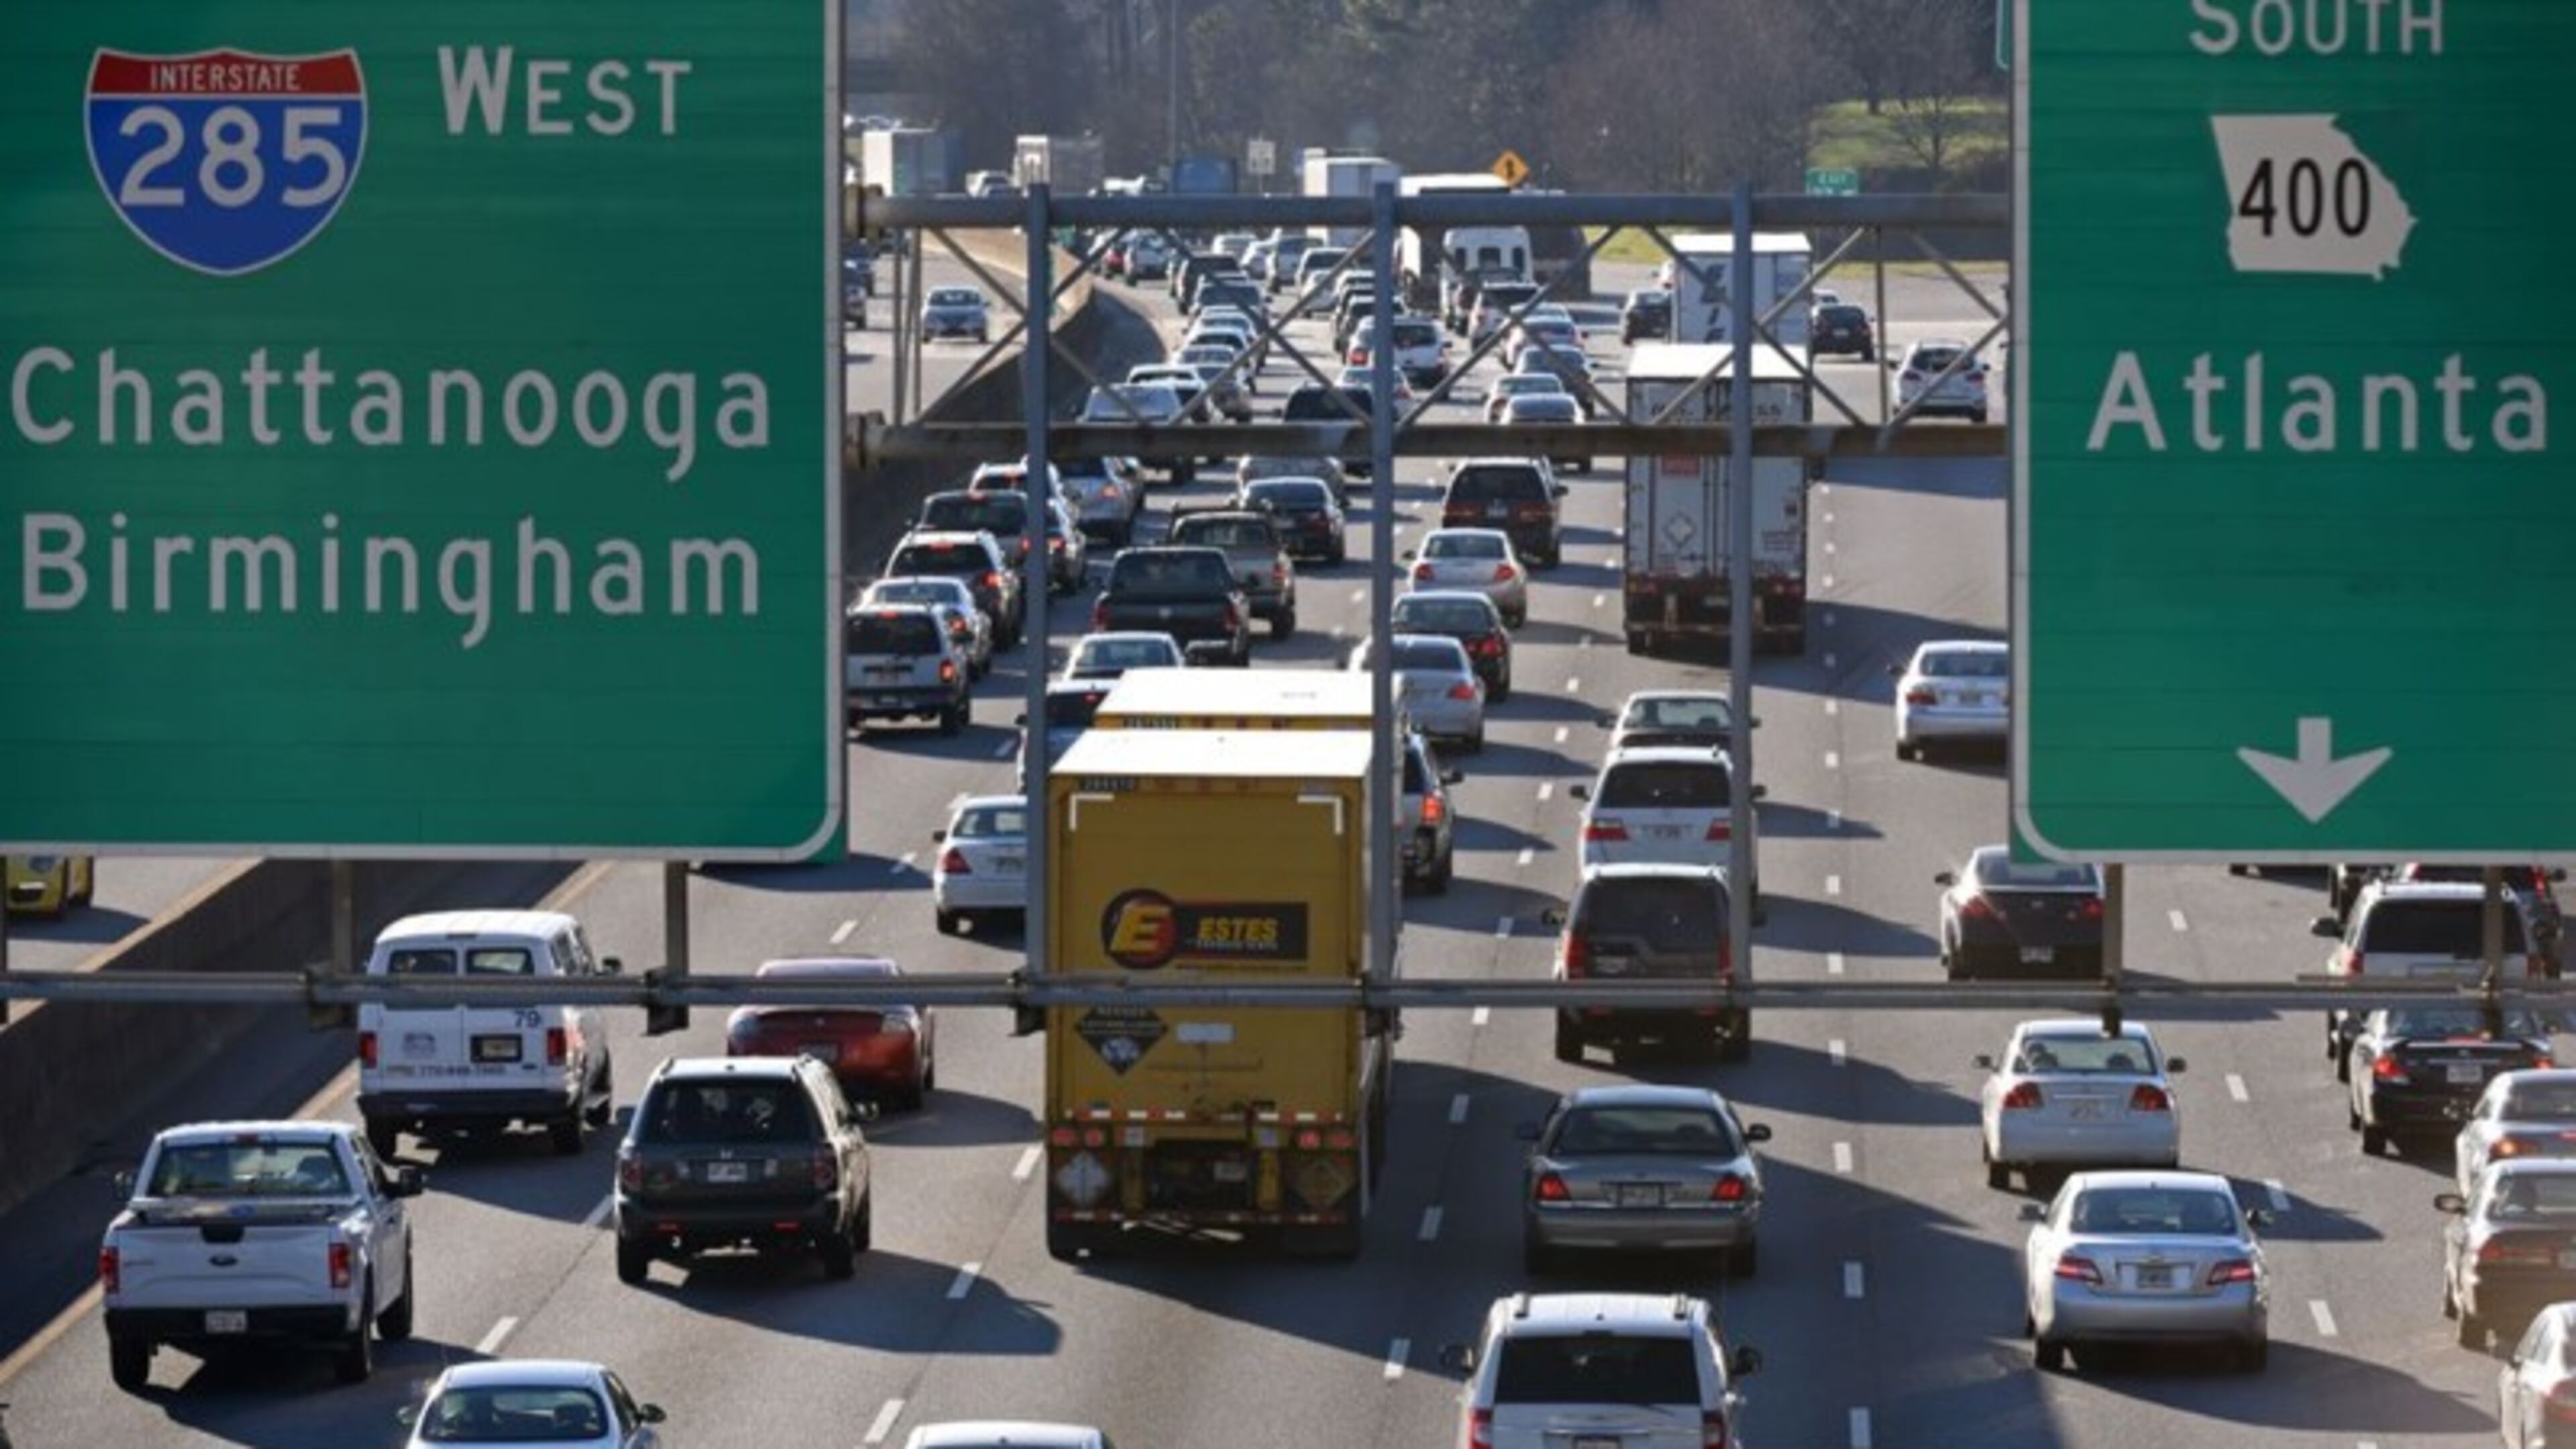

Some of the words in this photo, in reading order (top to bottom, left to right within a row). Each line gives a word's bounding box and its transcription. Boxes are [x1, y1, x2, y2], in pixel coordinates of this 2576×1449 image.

[2190, 0, 2444, 55] SOUTH
[149, 63, 301, 92] INTERSTATE
[437, 46, 692, 135] WEST
[119, 106, 347, 208] 285
[2238, 158, 2371, 238] 400
[11, 347, 769, 481] Chattanooga
[2086, 350, 2547, 451] Atlanta
[23, 513, 759, 648] Birmingham
[1197, 916, 1279, 941] ESTES
[515, 1009, 541, 1028] 79
